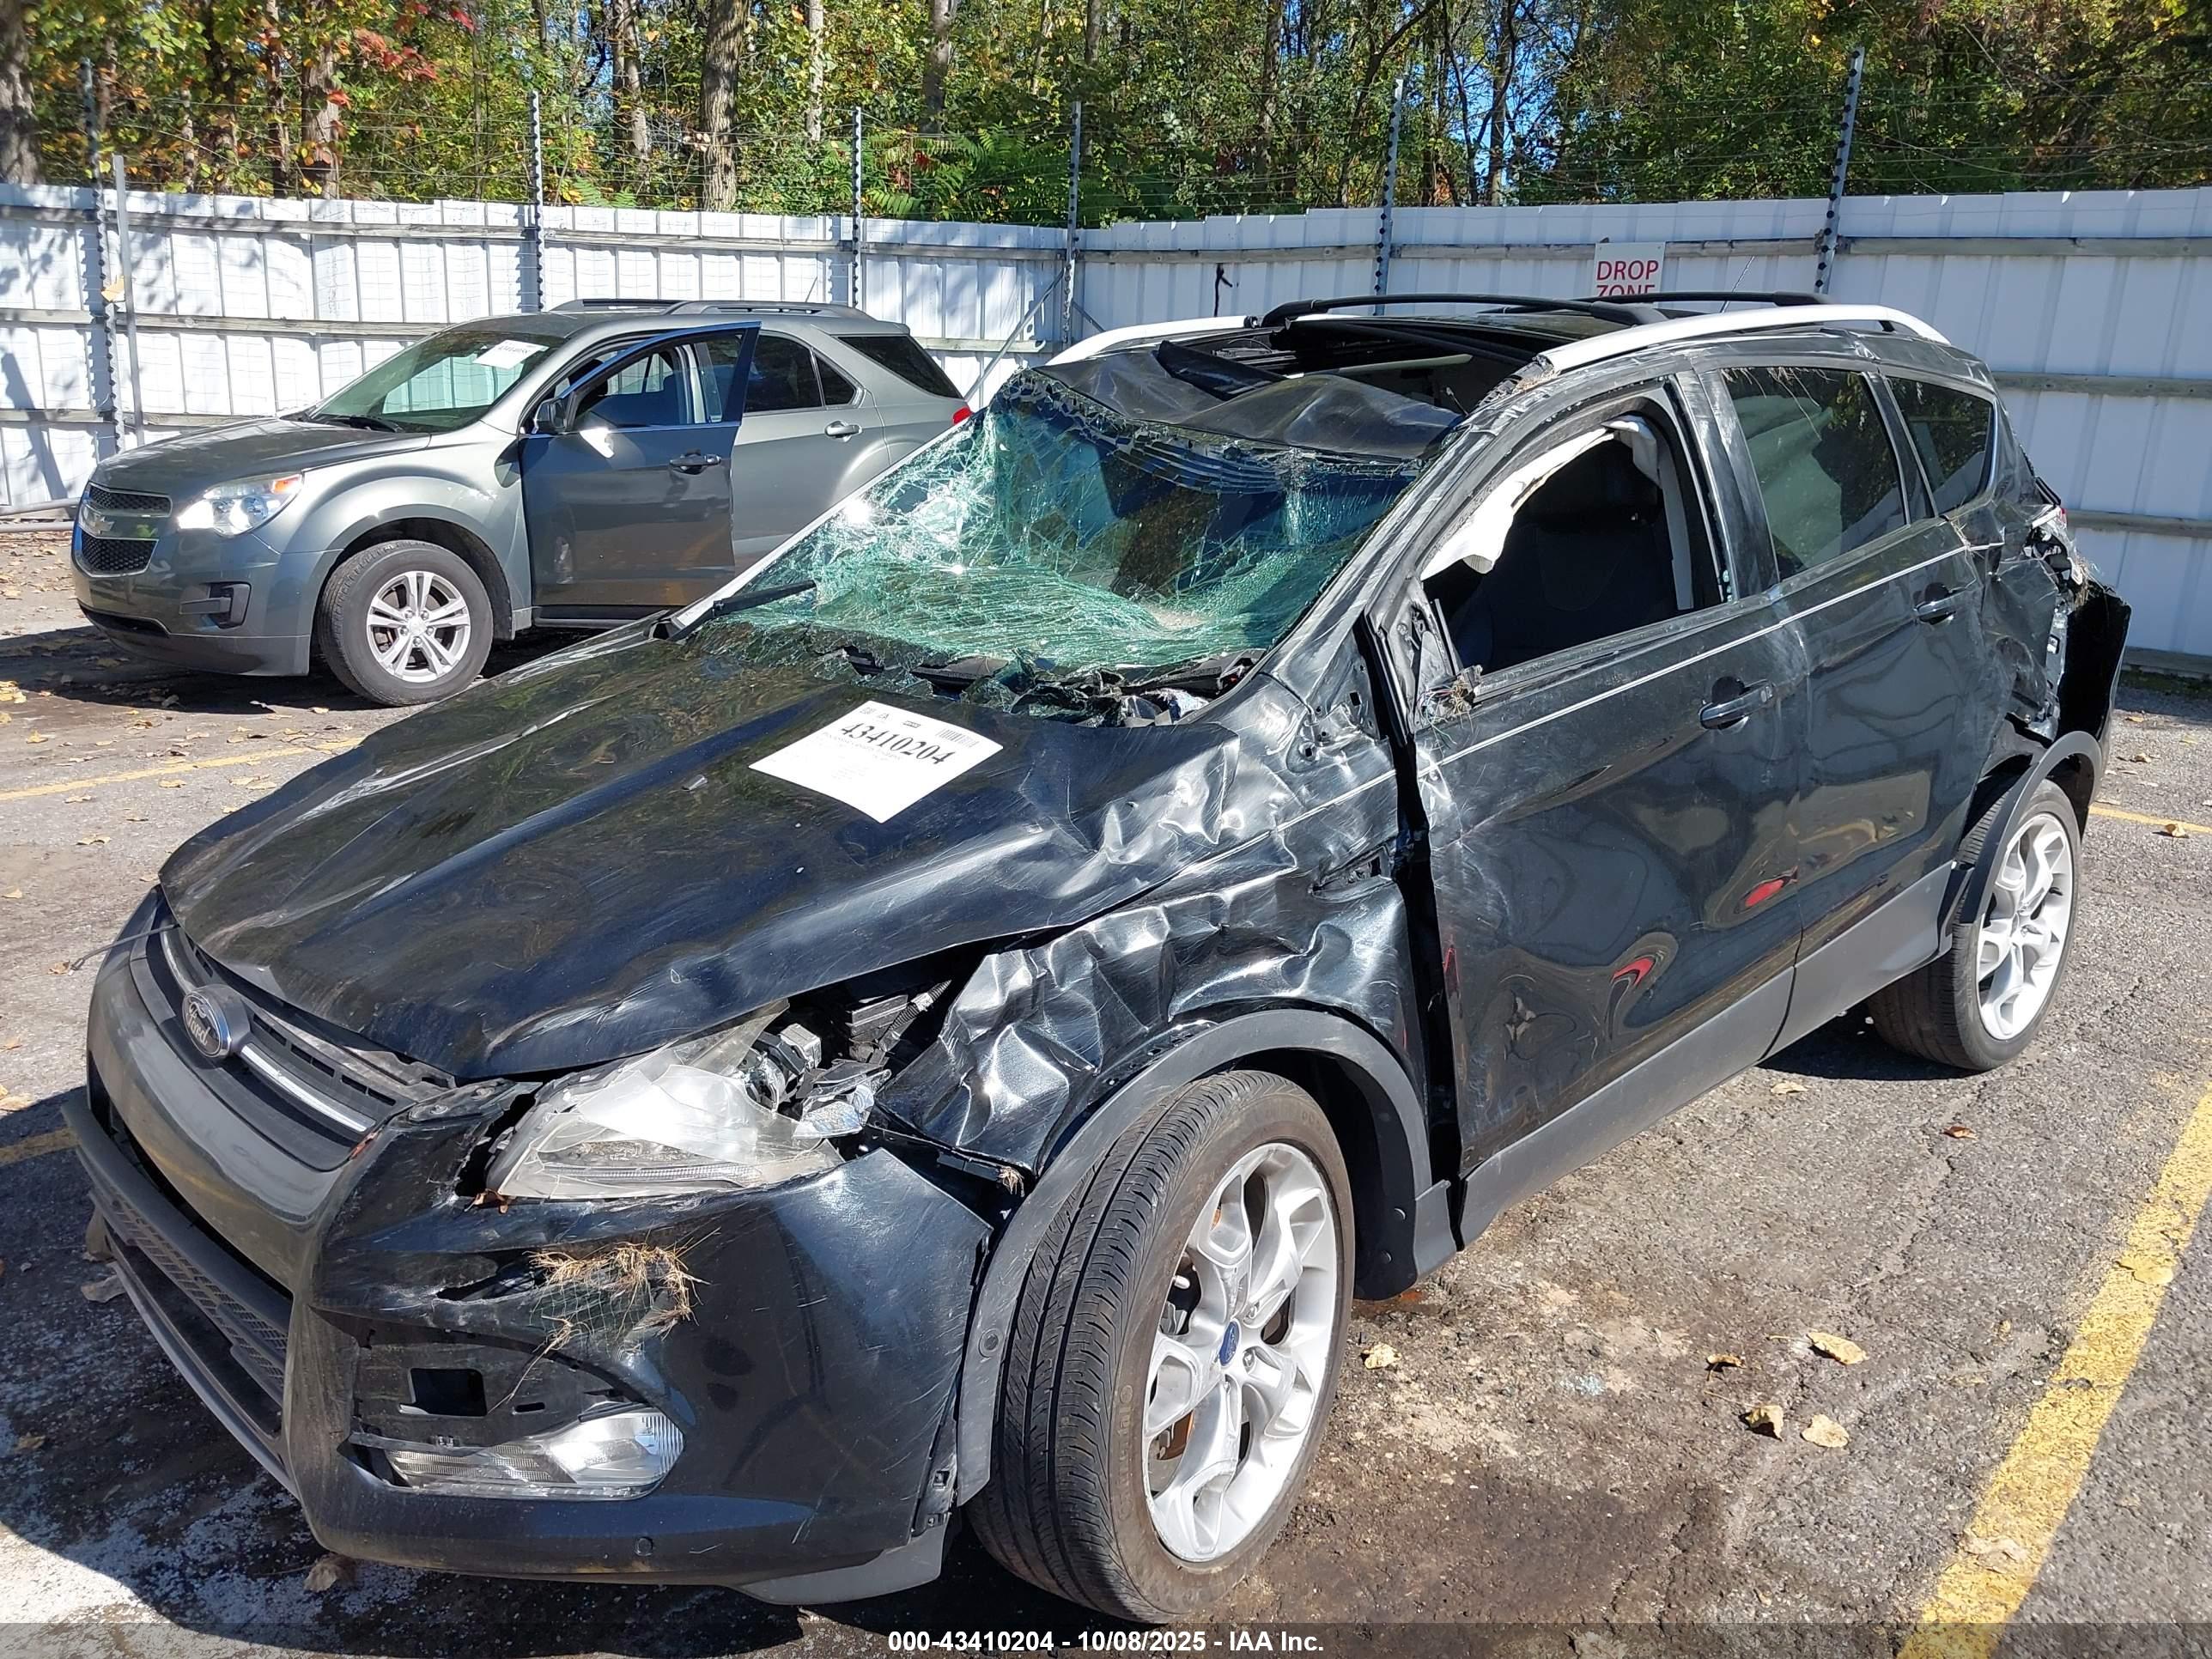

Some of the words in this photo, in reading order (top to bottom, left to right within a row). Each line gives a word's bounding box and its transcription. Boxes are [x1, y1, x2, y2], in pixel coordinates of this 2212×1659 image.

[1596, 259, 1659, 281] DROP
[840, 722, 957, 765] 43410204
[185, 1000, 210, 1045] Ford
